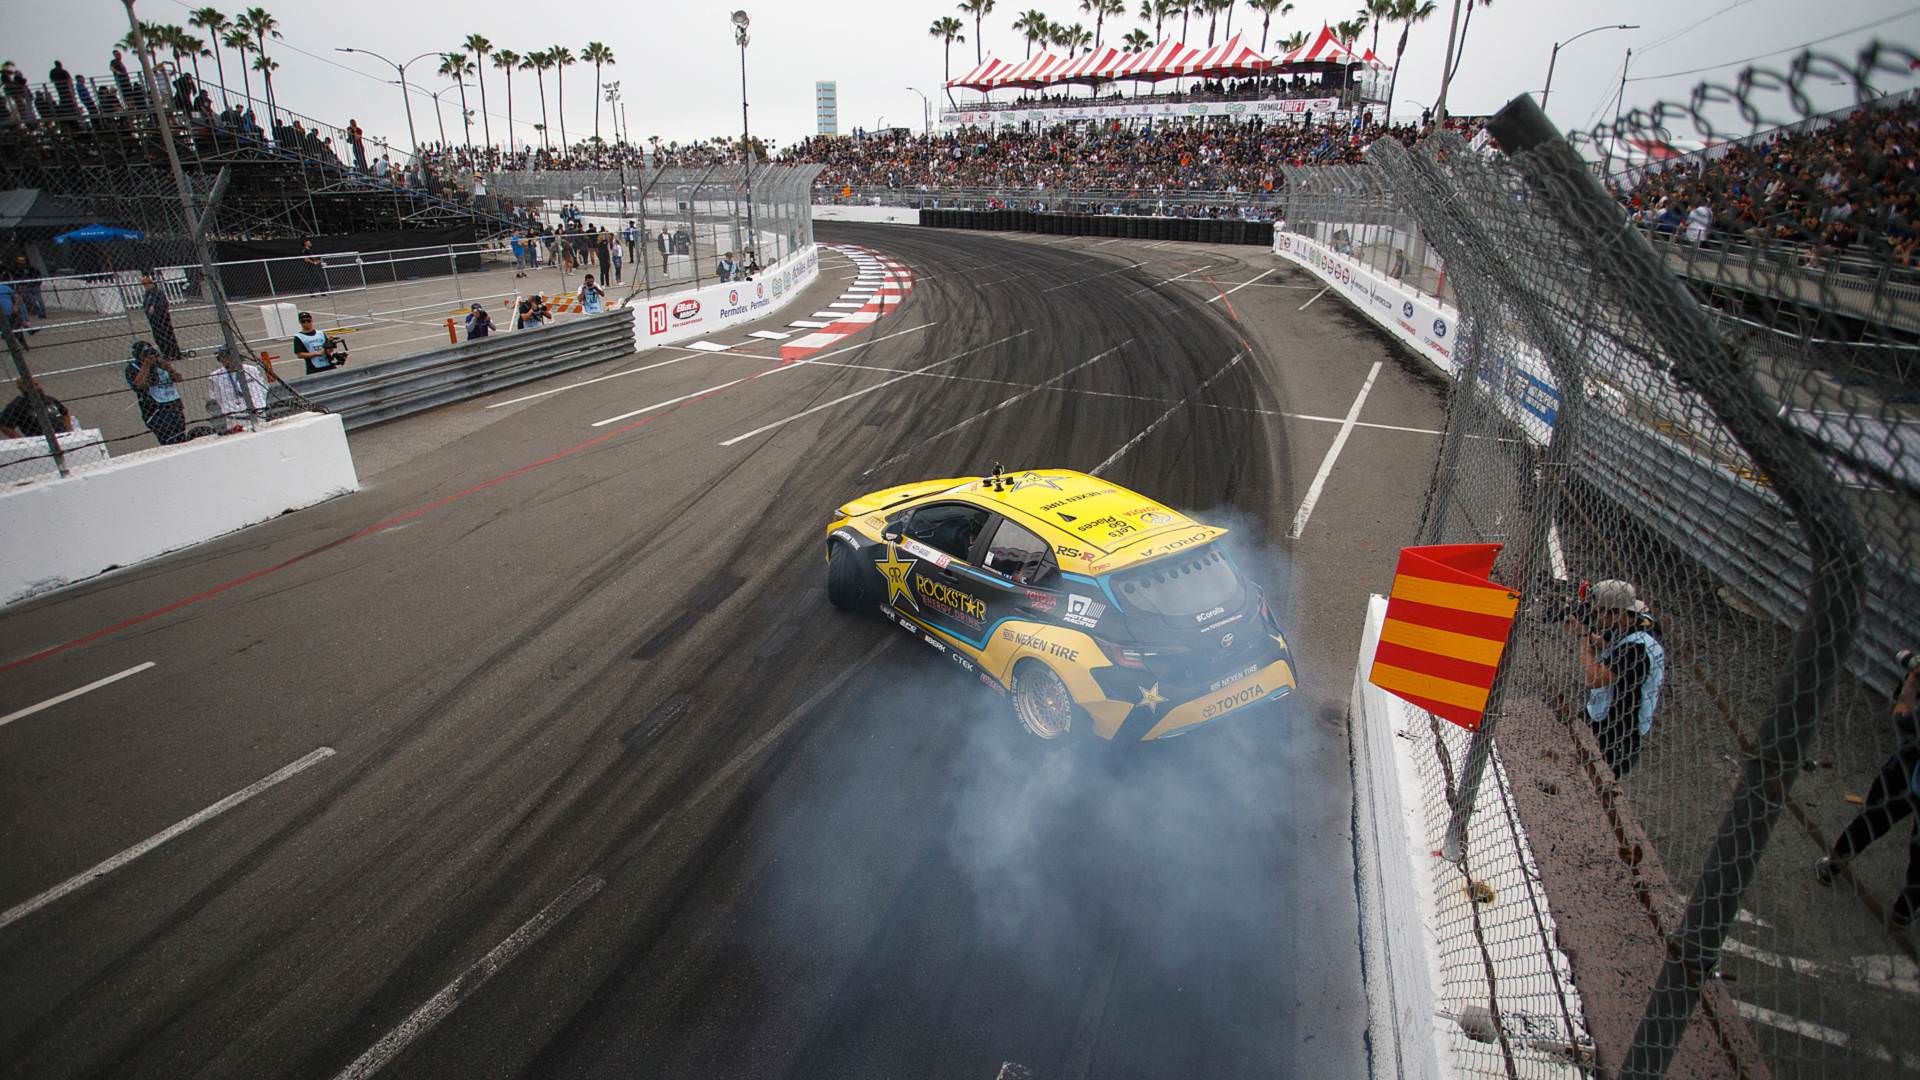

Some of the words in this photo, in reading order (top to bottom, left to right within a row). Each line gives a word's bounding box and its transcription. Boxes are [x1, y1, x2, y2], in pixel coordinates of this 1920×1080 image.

[1257, 102, 1283, 111] FORMULA
[1283, 101, 1305, 112] DRIFT
[720, 305, 748, 318] Permatex
[1040, 499, 1068, 512] TIRE
[1078, 515, 1117, 532] Places
[1108, 520, 1127, 530] Go
[1108, 523, 1137, 539] Let's
[1015, 633, 1048, 651] NEXEN
[1049, 643, 1079, 663] TIRE
[952, 653, 973, 672] CTEK
[1215, 684, 1264, 712] TOYOTA
